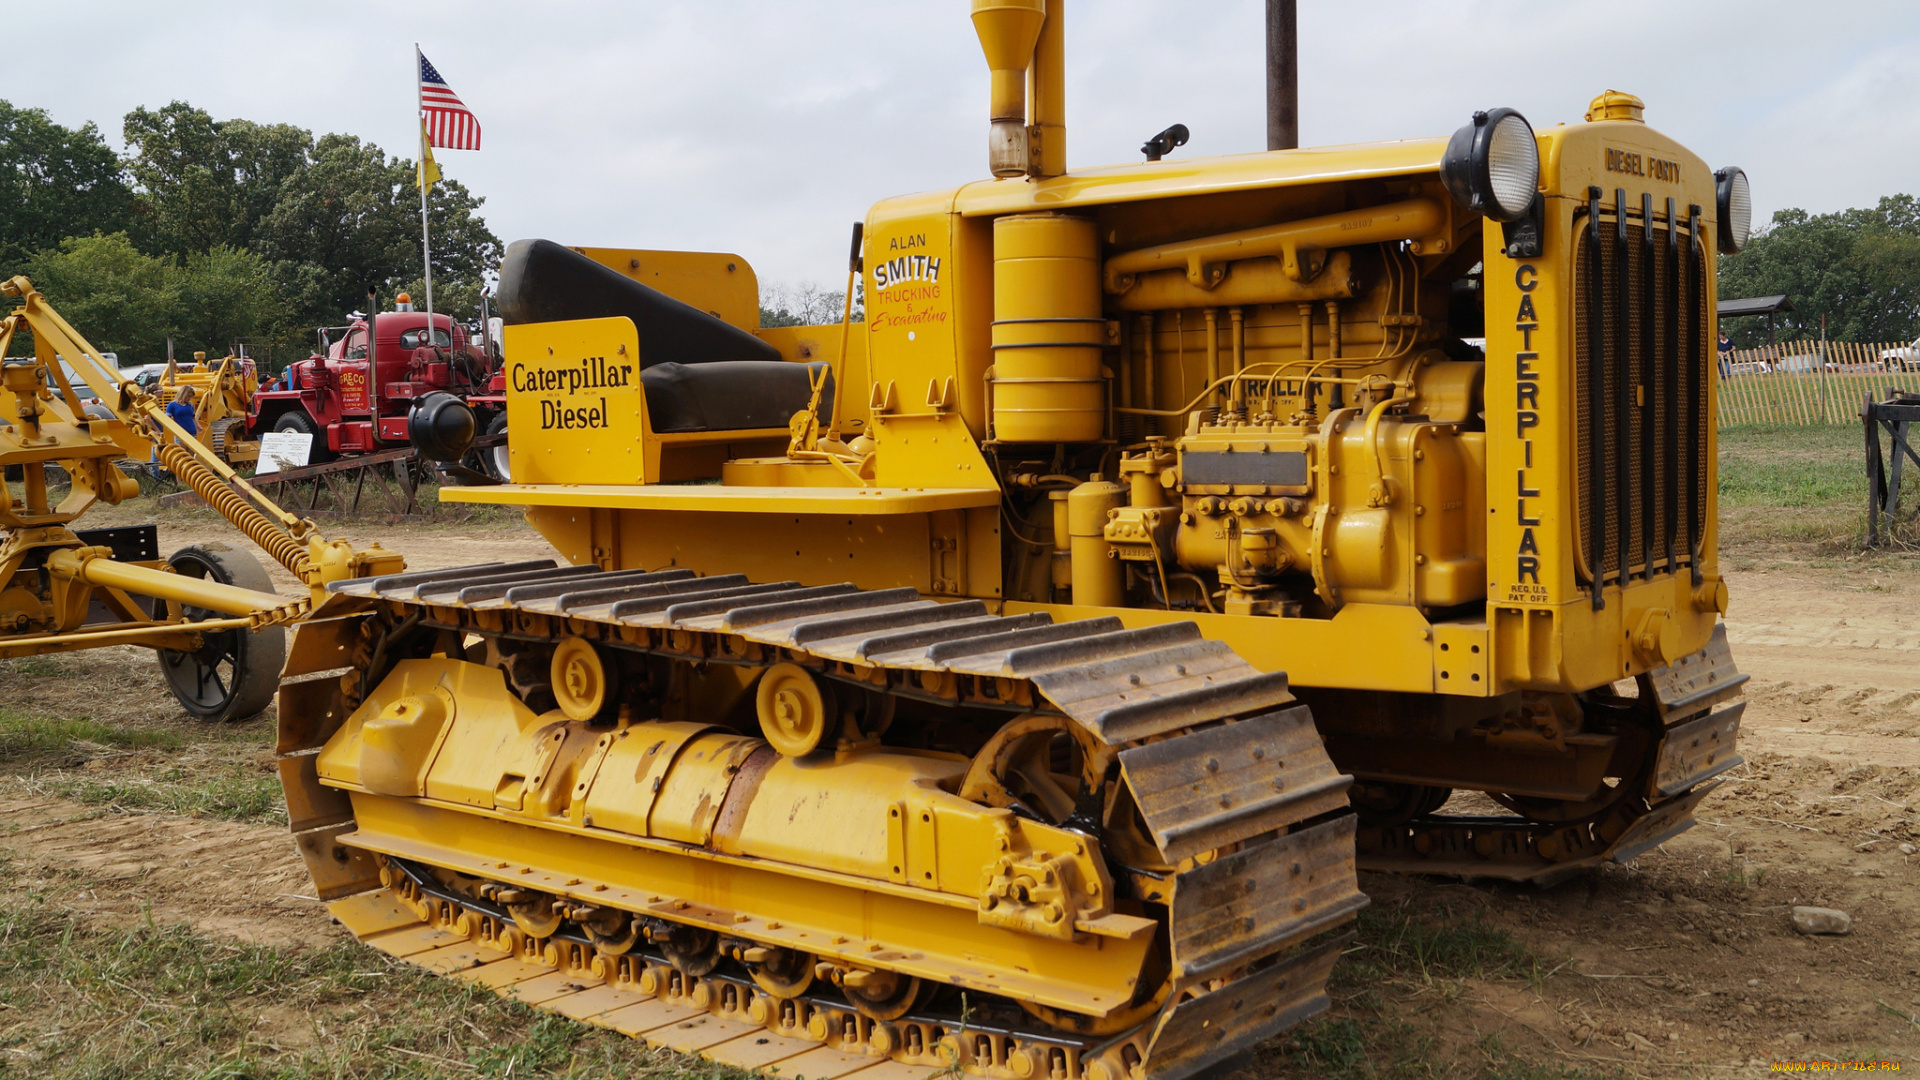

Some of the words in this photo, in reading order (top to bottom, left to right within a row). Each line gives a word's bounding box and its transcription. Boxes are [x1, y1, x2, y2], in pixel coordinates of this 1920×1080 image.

[1605, 147, 1645, 176] DIESEL
[1648, 156, 1681, 184] FORTY
[889, 233, 926, 251] ALAN
[873, 255, 941, 291] SMITH
[877, 285, 941, 304] TRUCKING
[871, 305, 947, 332] Excavating
[339, 372, 365, 386] GRECO
[512, 357, 632, 395] Caterpillar
[540, 397, 608, 430] Diesel
[1515, 264, 1541, 584] CATERPILLAR
